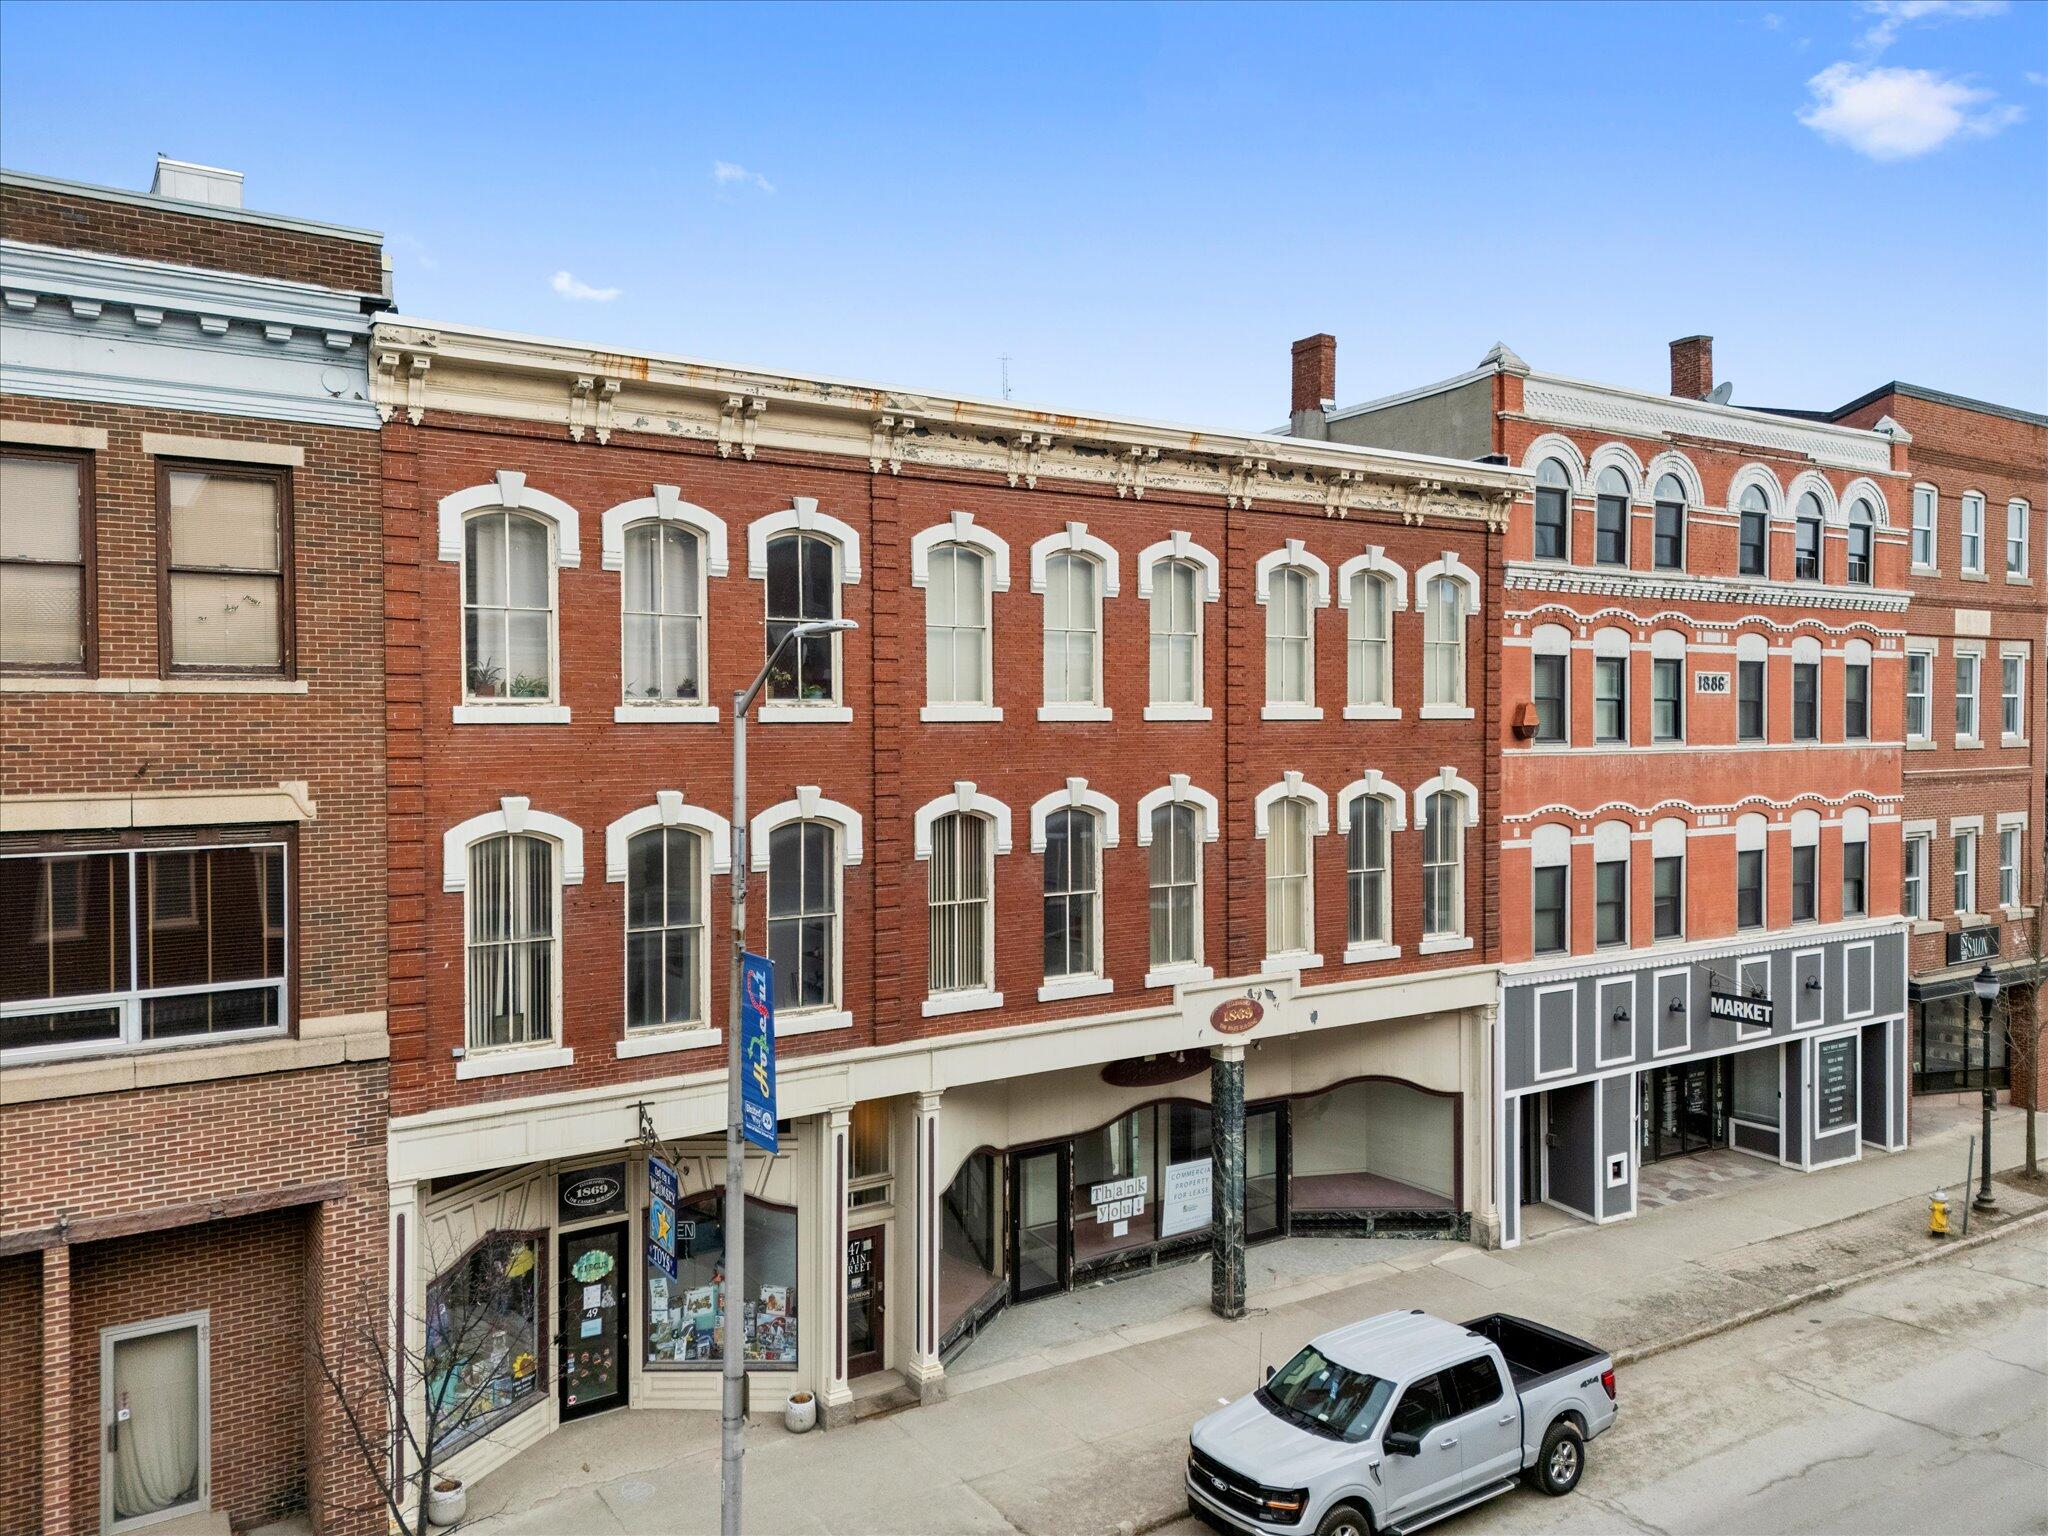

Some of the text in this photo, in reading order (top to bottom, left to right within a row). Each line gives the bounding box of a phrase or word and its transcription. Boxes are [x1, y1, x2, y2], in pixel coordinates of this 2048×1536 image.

[1698, 675, 1725, 692] 1886
[1223, 1007, 1254, 1022] 1869
[1711, 997, 1773, 1023] MARKET
[1171, 1166, 1211, 1181] COMMERCIA
[1093, 1179, 1147, 1202] Thank
[1175, 1177, 1209, 1190] PROPERTY
[576, 1184, 608, 1198] 1869
[1173, 1187, 1209, 1200] FOR LEASE
[677, 1223, 695, 1238] EN
[848, 1241, 860, 1255] 47
[652, 1244, 671, 1273] TOYS
[849, 1253, 867, 1265] AIN
[848, 1261, 871, 1274] REET
[586, 1308, 598, 1318] 49
